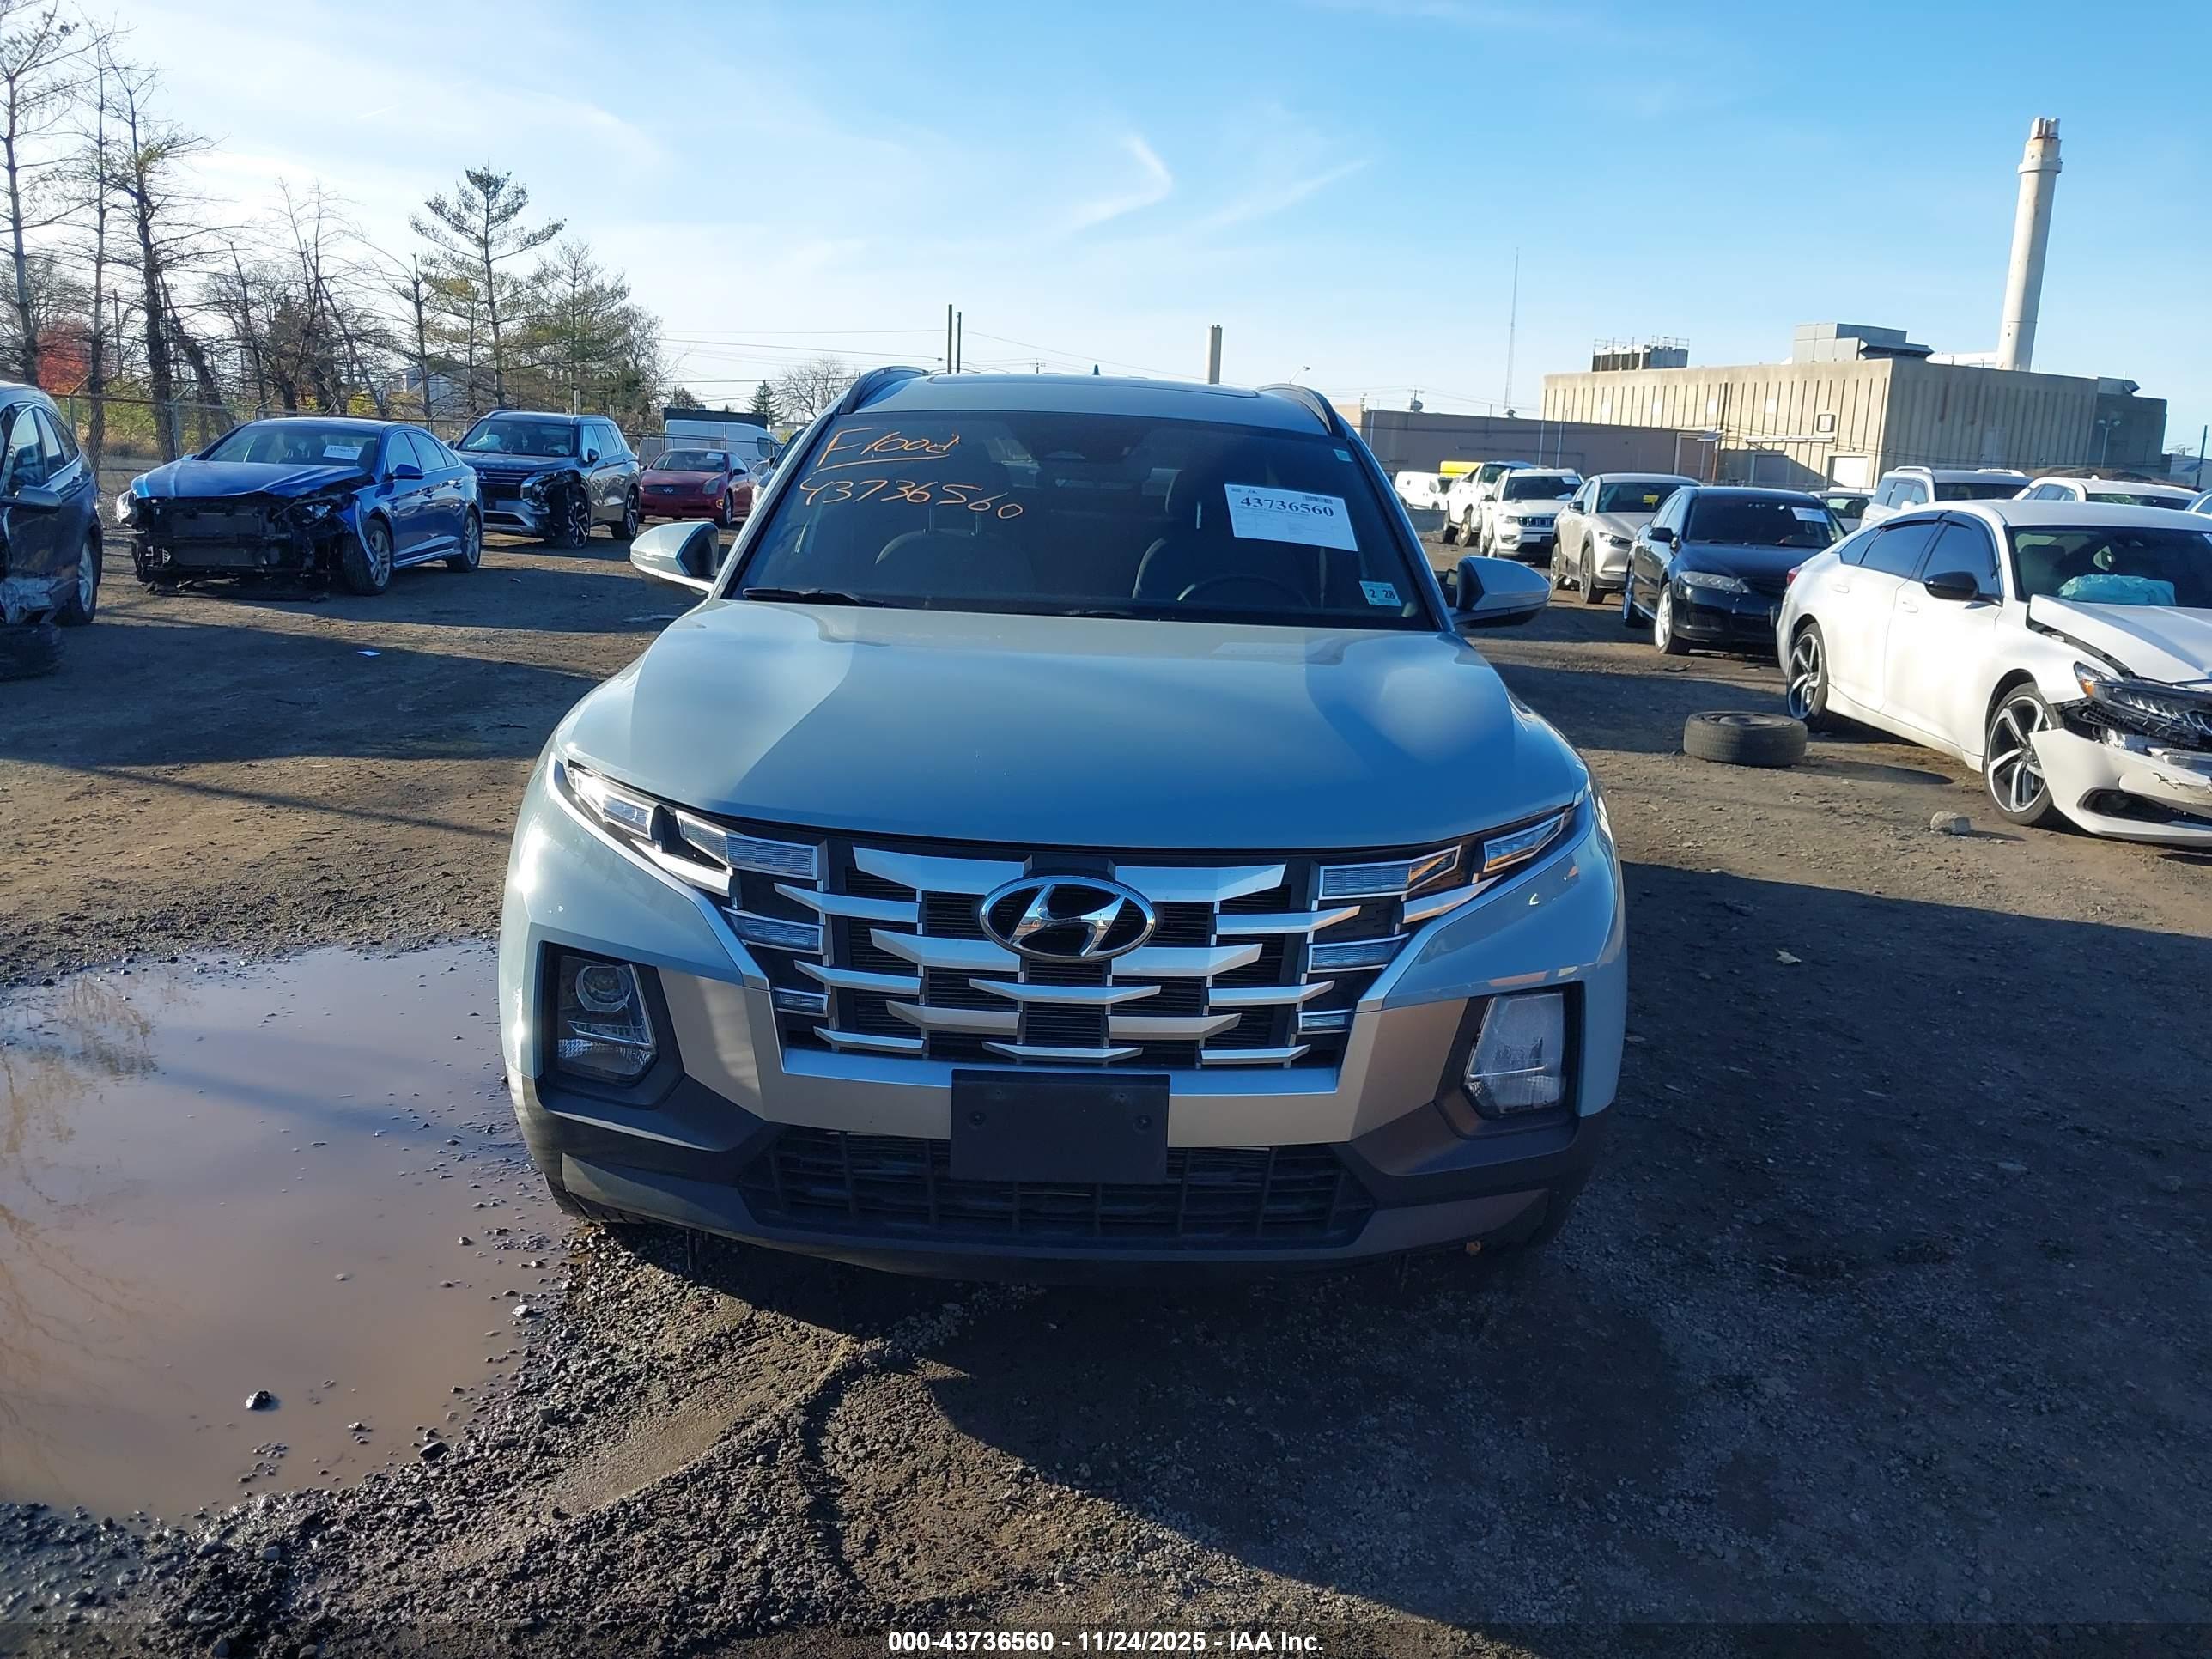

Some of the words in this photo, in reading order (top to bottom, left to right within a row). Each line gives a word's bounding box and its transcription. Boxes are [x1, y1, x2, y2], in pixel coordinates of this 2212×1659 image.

[817, 427, 960, 467] Flood
[799, 477, 1024, 519] 43736560
[1240, 495, 1334, 517] 43736560
